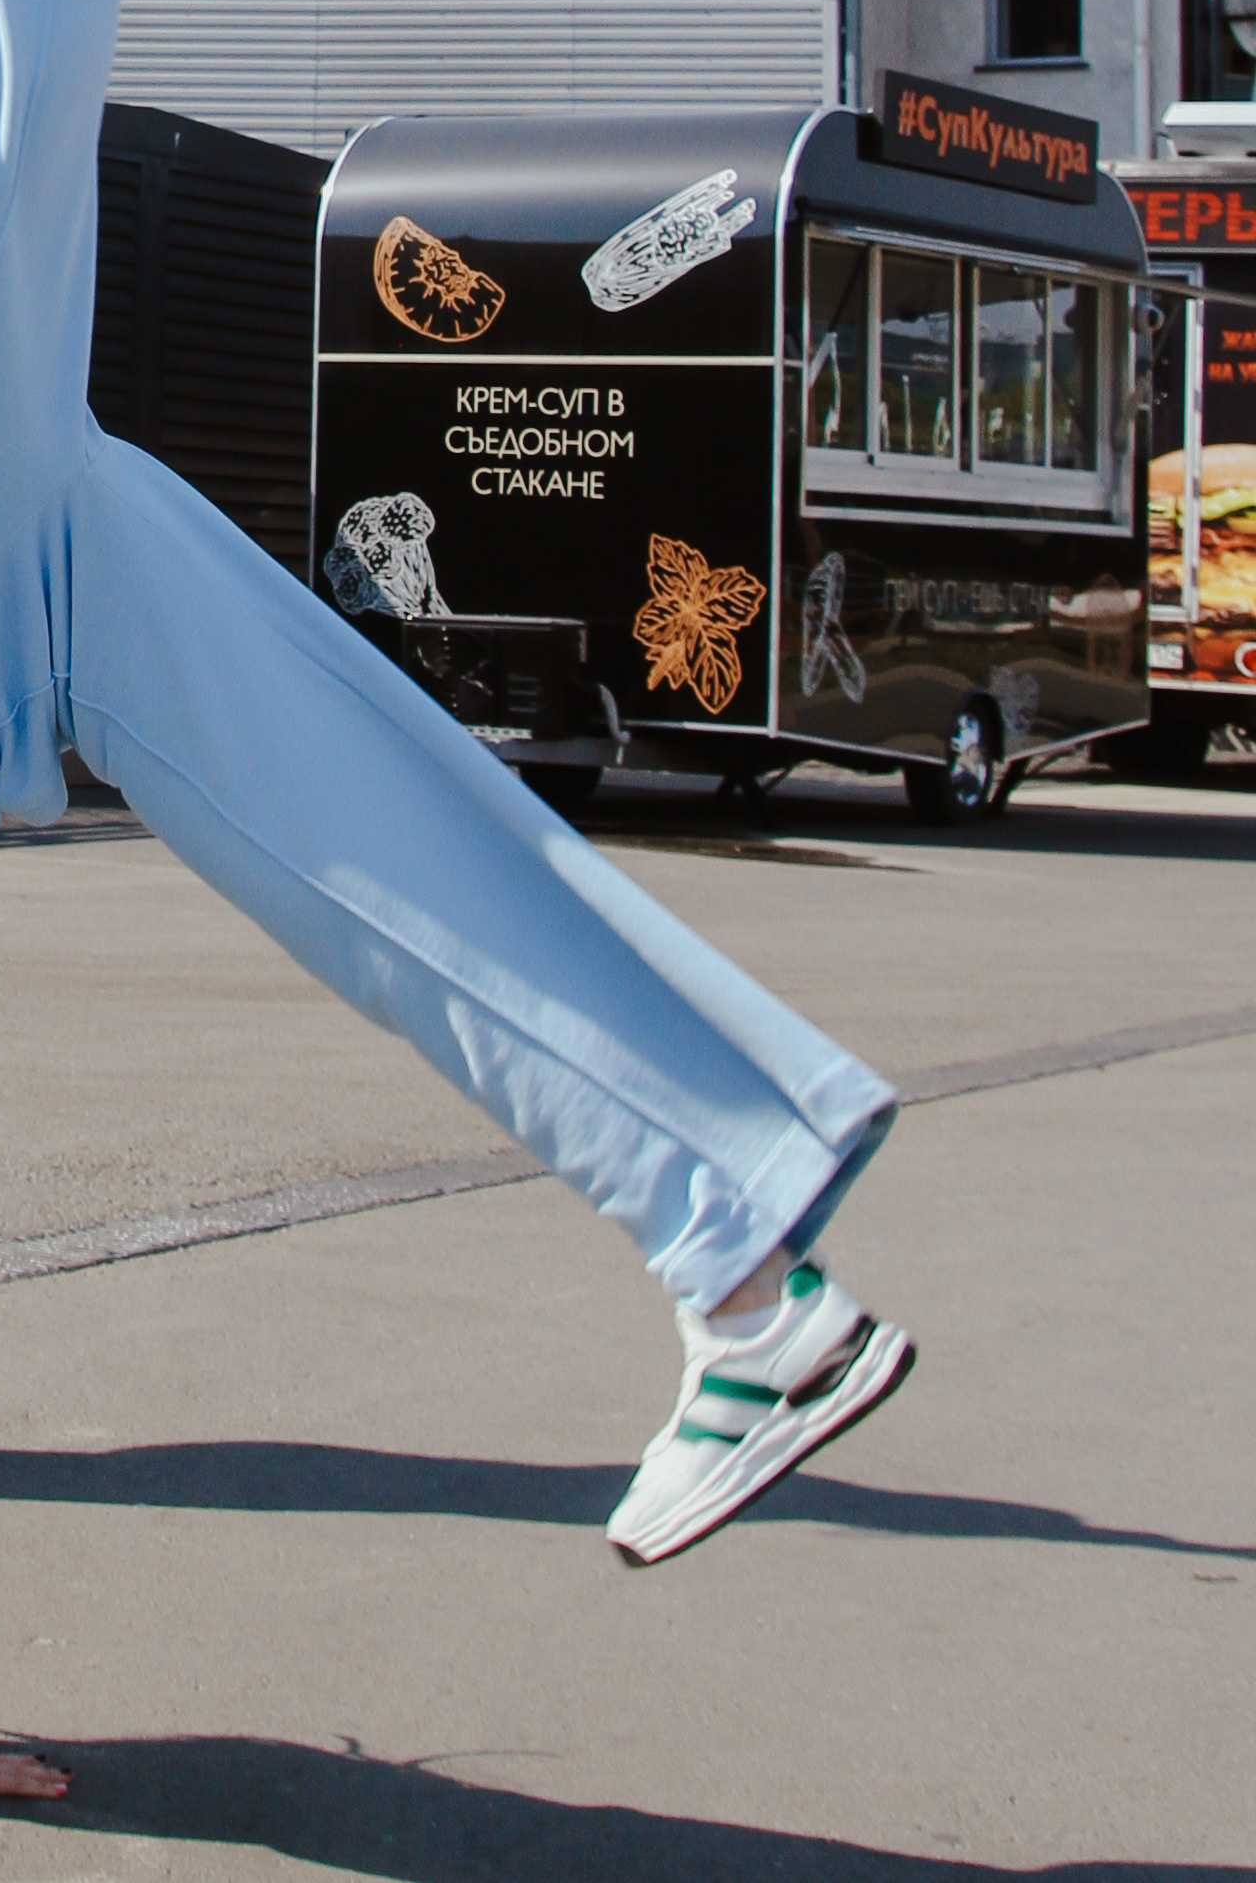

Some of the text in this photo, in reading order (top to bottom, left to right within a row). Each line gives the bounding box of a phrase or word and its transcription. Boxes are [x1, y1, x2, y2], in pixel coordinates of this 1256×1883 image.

[898, 89, 1089, 184] #СупКультура
[456, 386, 626, 419] КРЕМ-СУП В
[444, 425, 634, 460] СЪЕДОБНОМ
[471, 467, 605, 500] СТАКАНЕ
